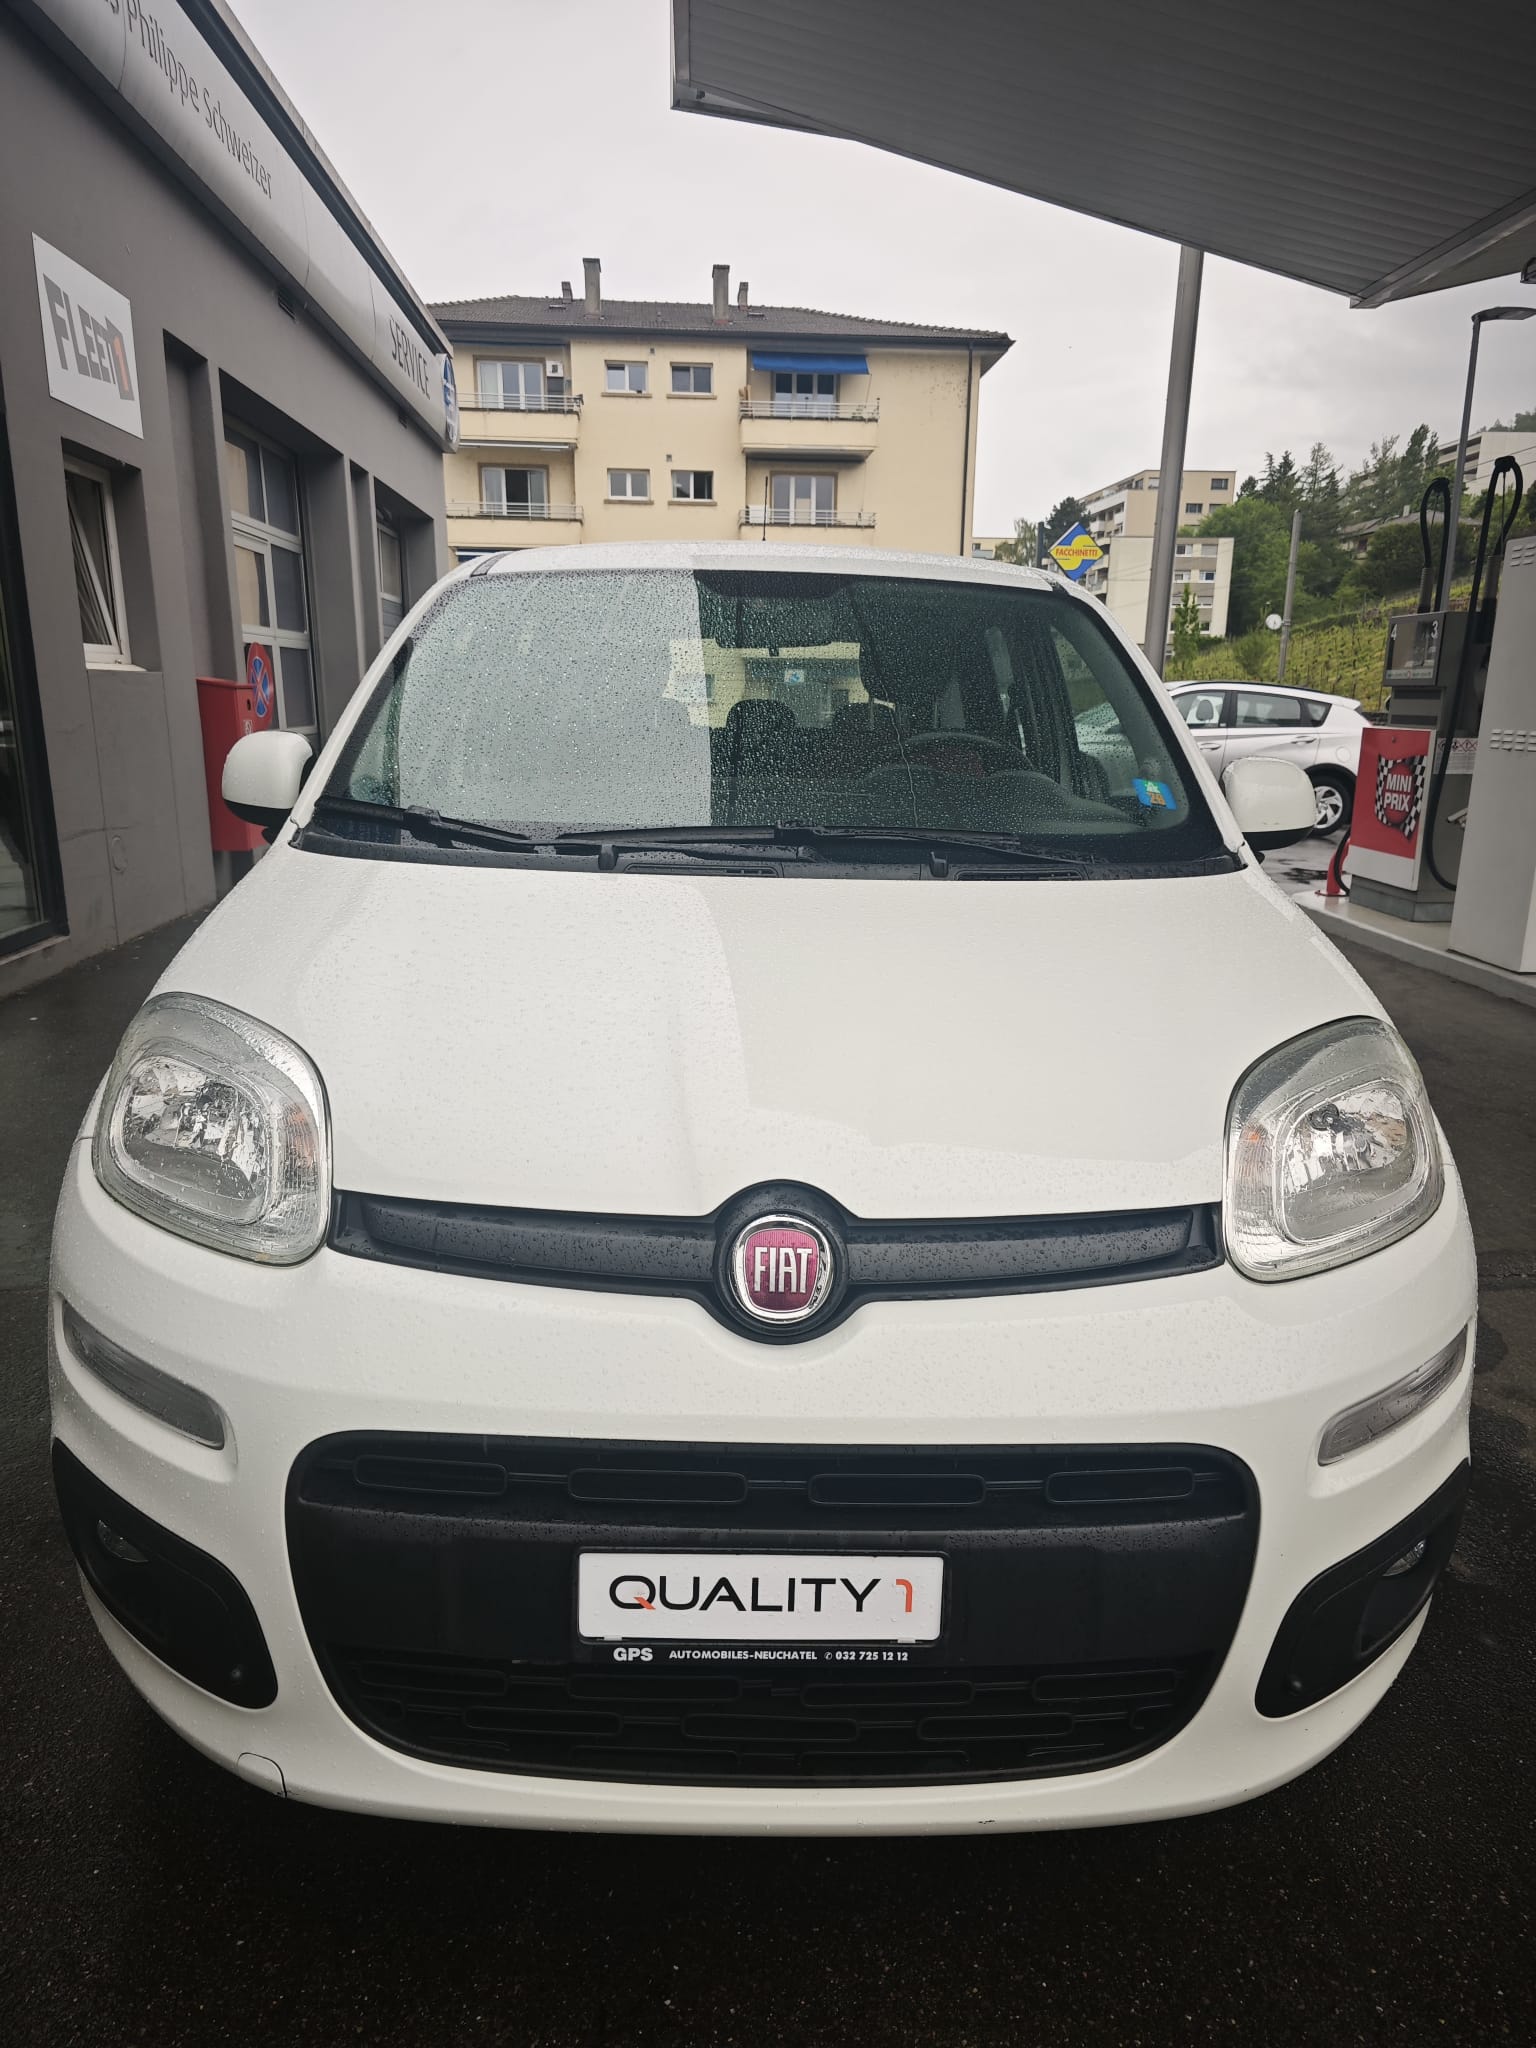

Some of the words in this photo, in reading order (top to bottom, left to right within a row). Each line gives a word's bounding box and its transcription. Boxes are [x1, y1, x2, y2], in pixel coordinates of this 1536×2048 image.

[203, 87, 272, 200] Schweizer
[389, 314, 430, 401] SERVICE
[1056, 548, 1098, 558] FACCHINETTI
[1390, 623, 1398, 641] 4
[1430, 620, 1439, 639] 3
[1386, 773, 1412, 793] MINI
[1383, 791, 1410, 812] PRIX
[754, 1246, 813, 1294] FIAT
[613, 1647, 654, 1662] GPS
[669, 1650, 818, 1661] AUTOMOBILES-NEUCHATEL
[835, 1651, 856, 1661] 032
[859, 1651, 879, 1661] 725
[882, 1651, 894, 1661] 12
[897, 1651, 909, 1662] 12
